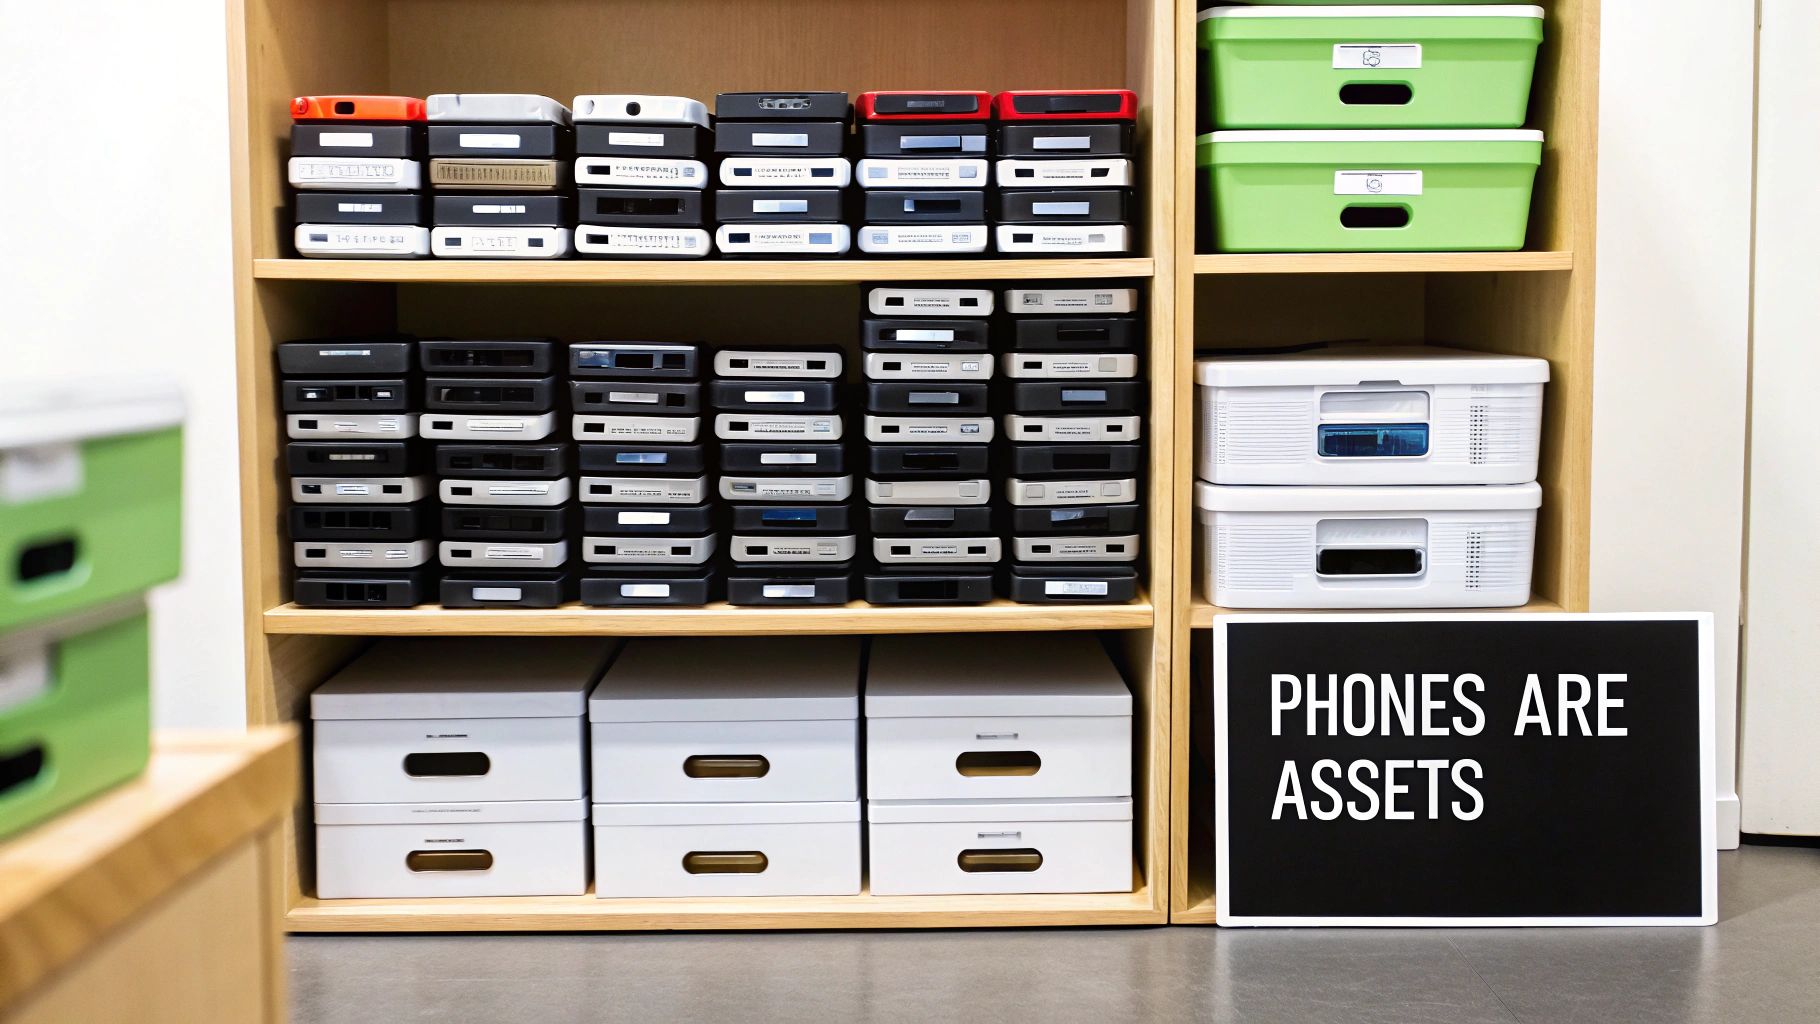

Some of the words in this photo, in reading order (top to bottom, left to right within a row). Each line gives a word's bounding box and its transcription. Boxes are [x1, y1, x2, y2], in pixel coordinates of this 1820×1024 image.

[1272, 673, 1486, 737] PHONES
[1514, 673, 1628, 737] ARE
[1272, 759, 1485, 821] ASSETS
